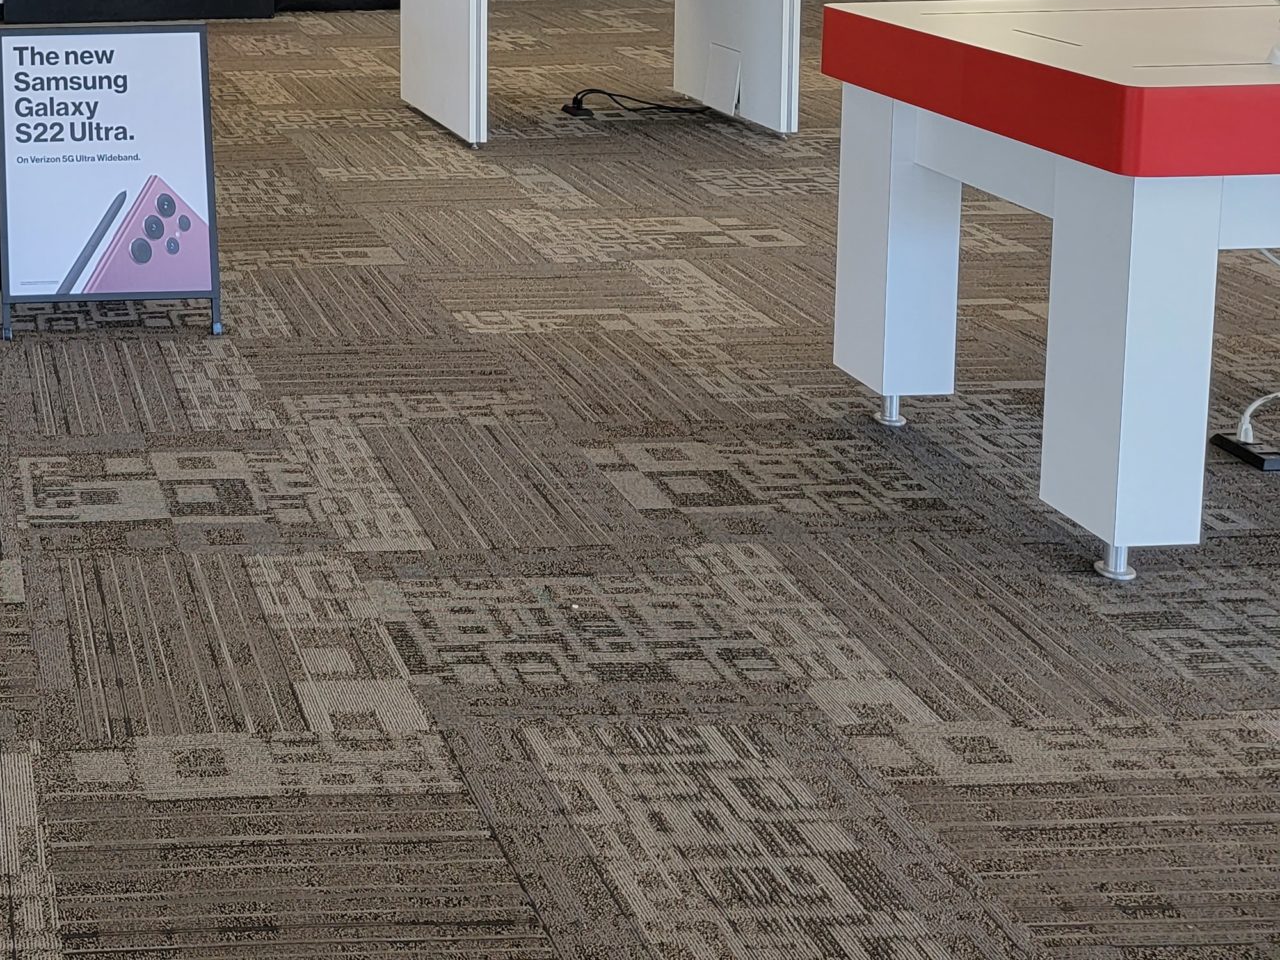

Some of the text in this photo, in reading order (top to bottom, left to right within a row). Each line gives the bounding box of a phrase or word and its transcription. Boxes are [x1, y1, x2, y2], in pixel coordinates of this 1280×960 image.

[13, 46, 115, 66] The new
[14, 71, 128, 94] Samsung
[14, 96, 99, 120] Galaxy
[15, 121, 135, 143] S22 Ultra.
[16, 153, 141, 164] On Verizon 5G Ultra Wideband.
